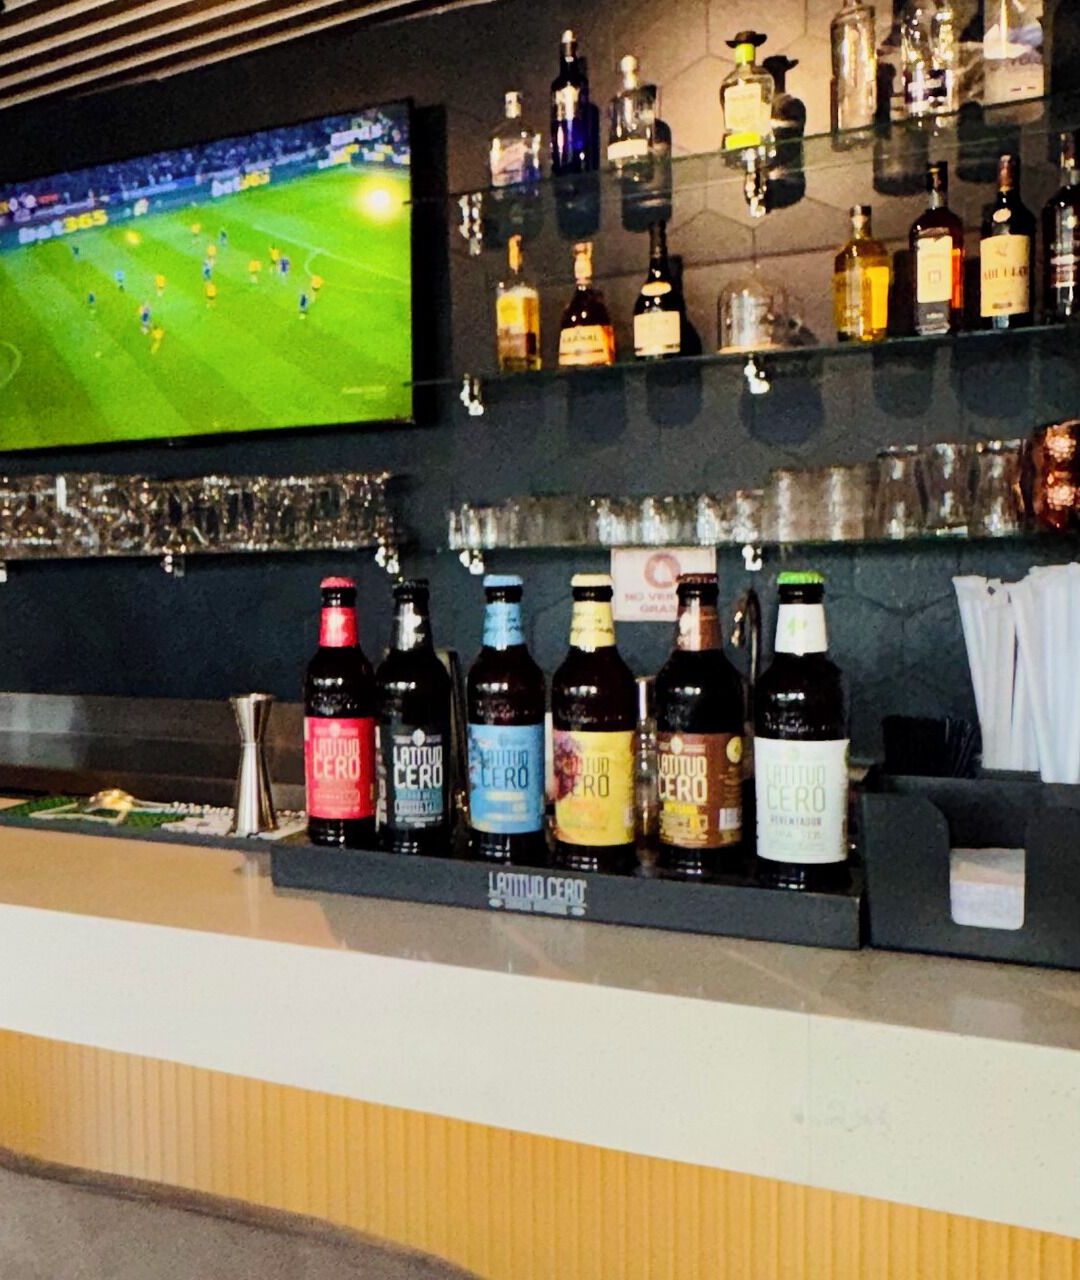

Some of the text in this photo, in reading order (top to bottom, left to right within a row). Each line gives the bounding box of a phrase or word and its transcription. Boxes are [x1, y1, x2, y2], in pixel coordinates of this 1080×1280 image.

[313, 739, 360, 759] LATITUD
[393, 746, 443, 768] LATITUD
[480, 749, 528, 768] LATITUD
[313, 756, 360, 780] CERO
[658, 752, 707, 778] LATITUD
[766, 764, 825, 785] LATITUD
[394, 765, 443, 790] CERO
[481, 767, 528, 789] CERO
[658, 775, 707, 803] CERO
[767, 784, 826, 813] CERO
[488, 871, 585, 903] LATITUD CERO
